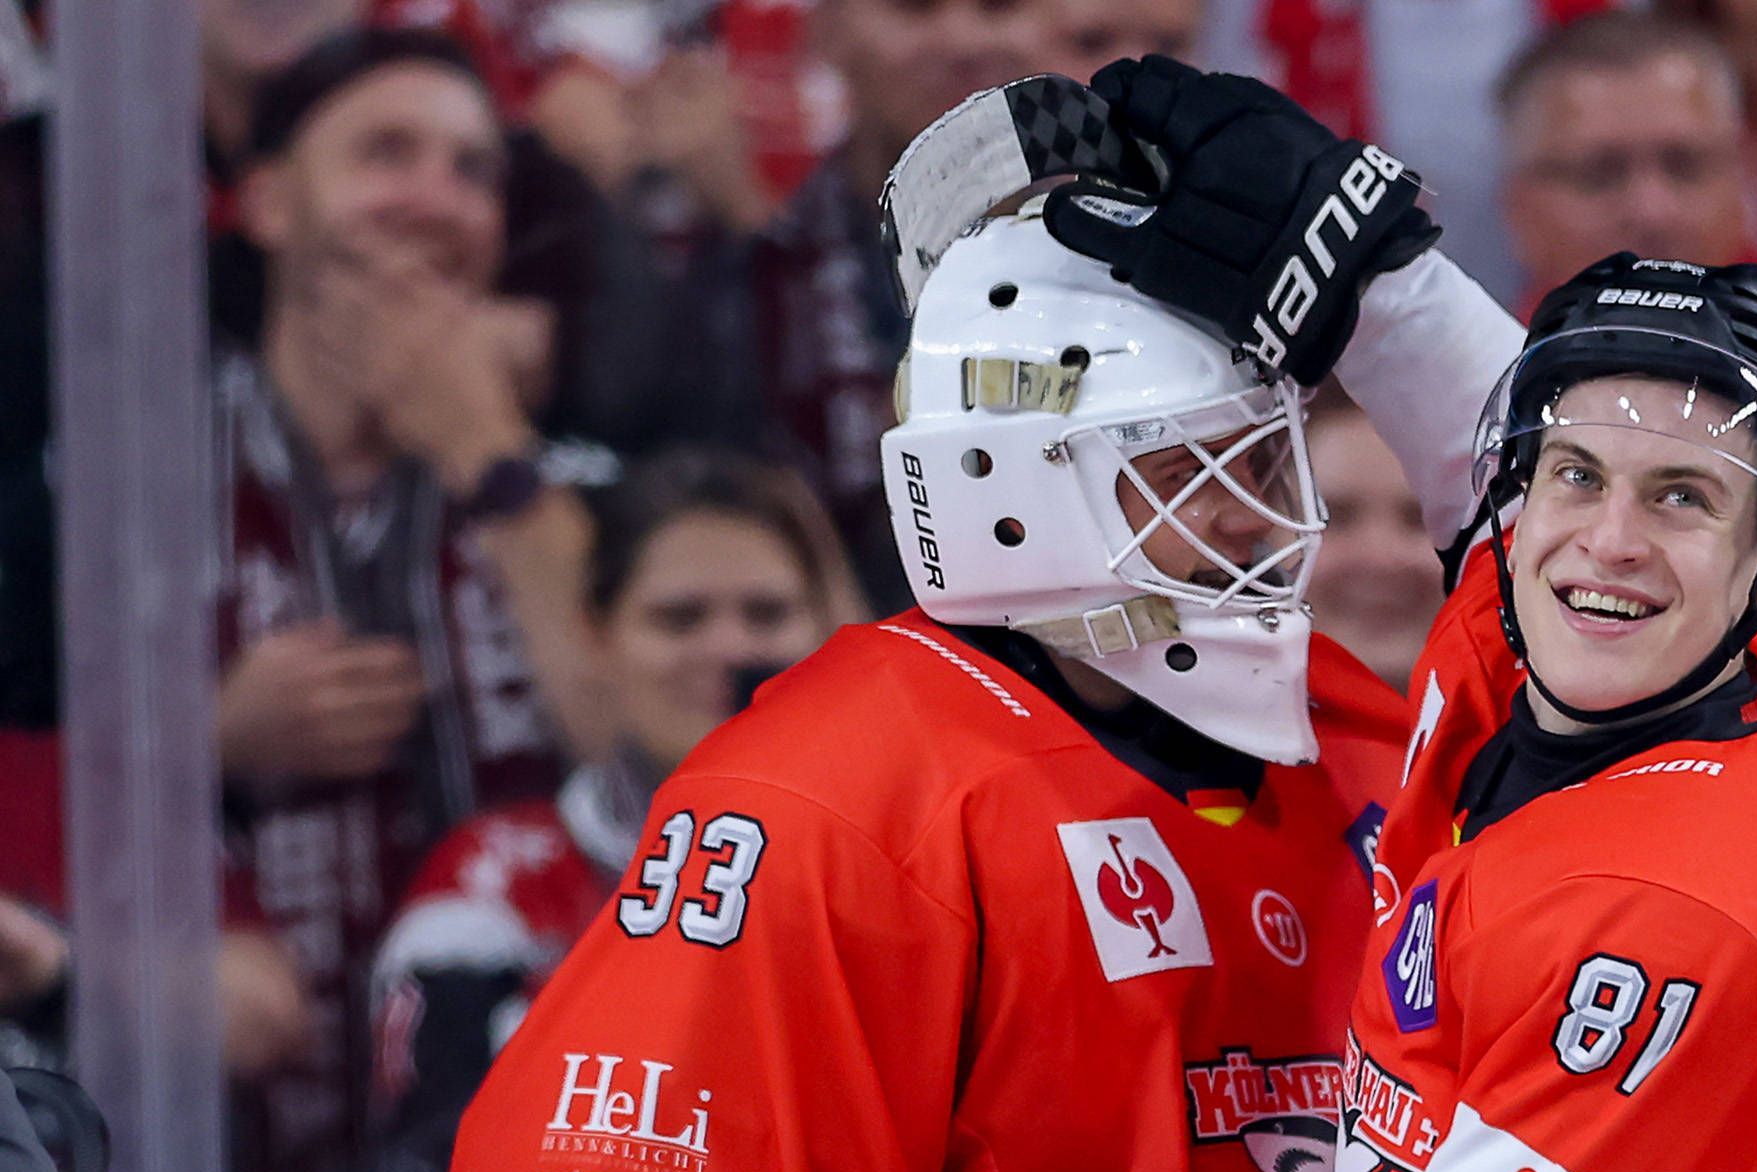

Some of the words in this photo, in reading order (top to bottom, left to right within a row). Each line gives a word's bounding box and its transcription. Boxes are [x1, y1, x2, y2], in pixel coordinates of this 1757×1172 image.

[1242, 144, 1404, 369] BAUER
[1597, 288, 1704, 312] BAUER
[901, 451, 945, 591] BAUER
[617, 810, 768, 949] 33
[1397, 901, 1434, 1010] CHL
[1556, 954, 1701, 1095] 81
[547, 1053, 710, 1154] HeLi
